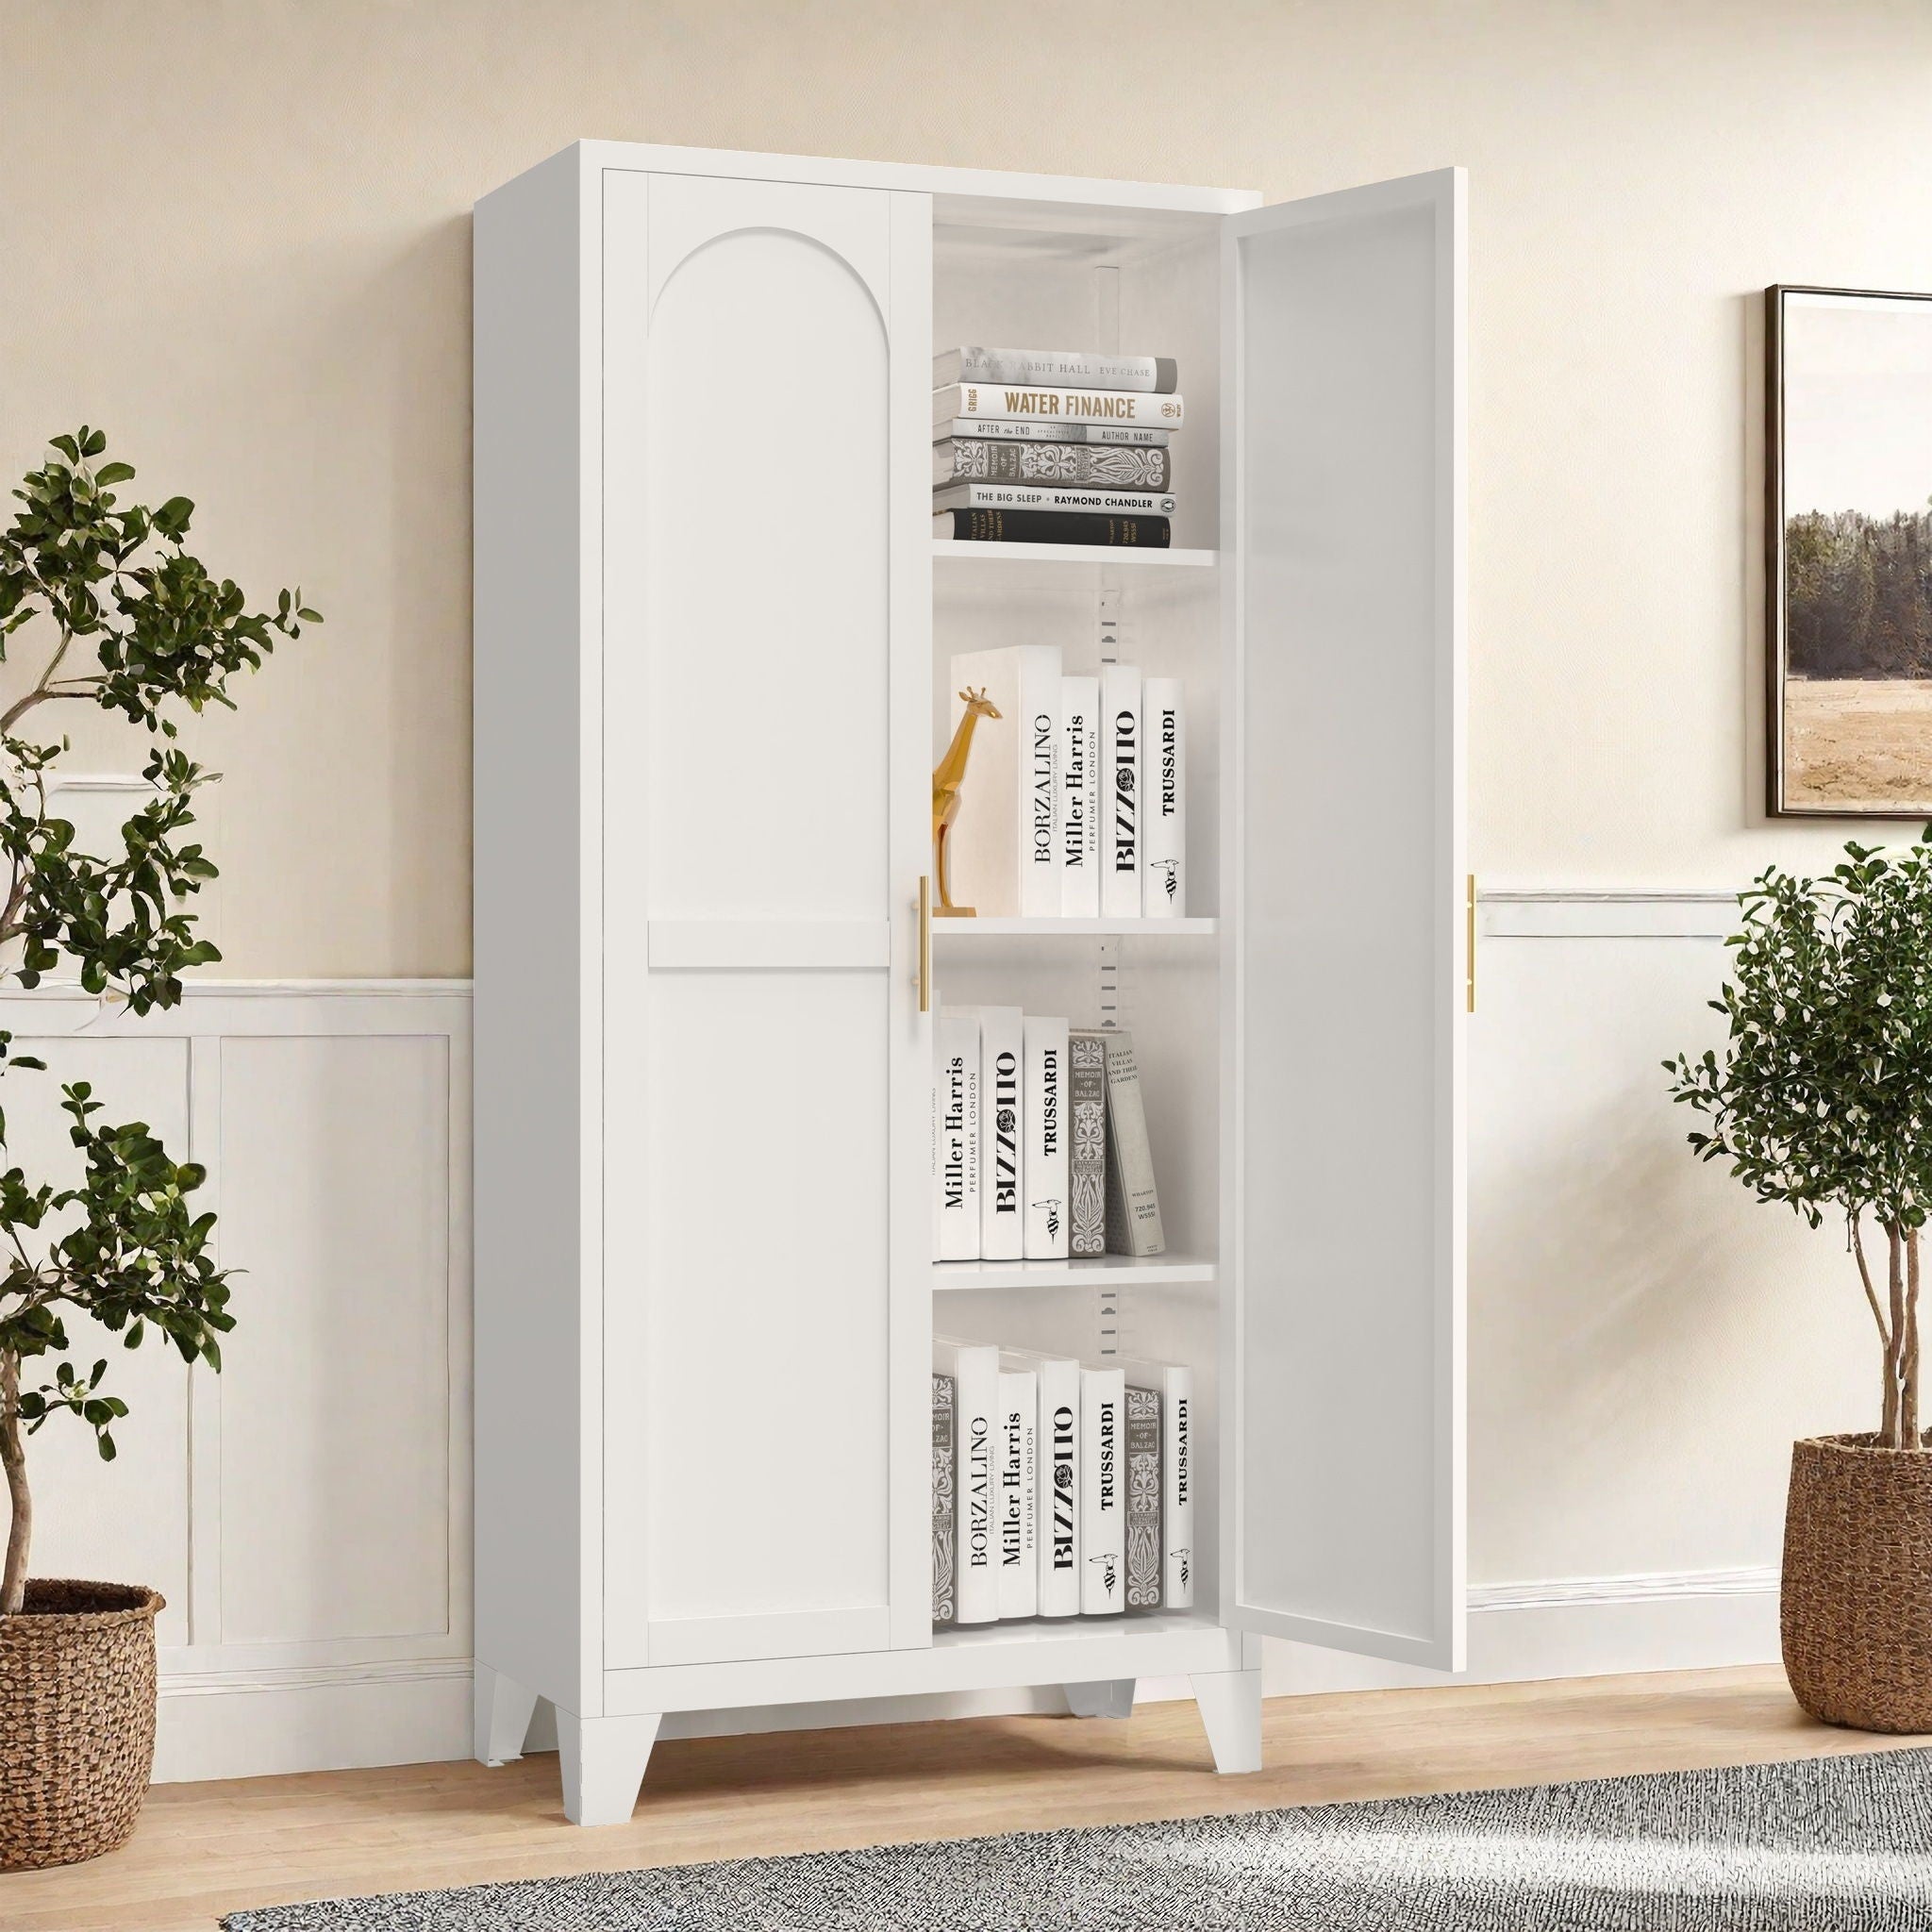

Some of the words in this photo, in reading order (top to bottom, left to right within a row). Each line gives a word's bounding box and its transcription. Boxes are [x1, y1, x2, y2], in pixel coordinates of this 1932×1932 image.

[968, 389, 977, 412] GRIGG
[1059, 363, 1091, 375] HALL
[1100, 366, 1117, 375] EVE
[1121, 368, 1150, 376] CHASE
[977, 425, 1000, 434] AFTER
[1015, 425, 1030, 435] END
[1005, 391, 1059, 415] WATER
[1065, 395, 1136, 419] FINANCE
[1102, 430, 1129, 441] AUTHOR
[1133, 432, 1154, 442] NAME
[976, 491, 993, 501] THE
[997, 492, 1013, 502] BIG
[1017, 493, 1041, 503] SLEEP
[1054, 495, 1102, 506] RAYMOND
[1105, 497, 1153, 508] CHANDLER
[1066, 715, 1084, 790] Harris
[1162, 709, 1175, 817] TRUSSARDI
[1034, 713, 1052, 864] BORZALINO
[1066, 796, 1083, 868] Miller
[945, 1057, 963, 1132] Harris
[1044, 1049, 1057, 1157] TRUSSARDI
[945, 1138, 963, 1209] Miller
[932, 1412, 950, 1421] MOIR
[1003, 1412, 1021, 1489] Harris
[1130, 1422, 1157, 1430] MEMOIR
[1130, 1441, 1156, 1449] BALZAC
[1178, 1398, 1188, 1506] TRUSSARDI
[971, 1416, 988, 1568] BORZALINO
[1101, 1403, 1114, 1511] TRUSSARDI
[1003, 1494, 1021, 1567] Miller
